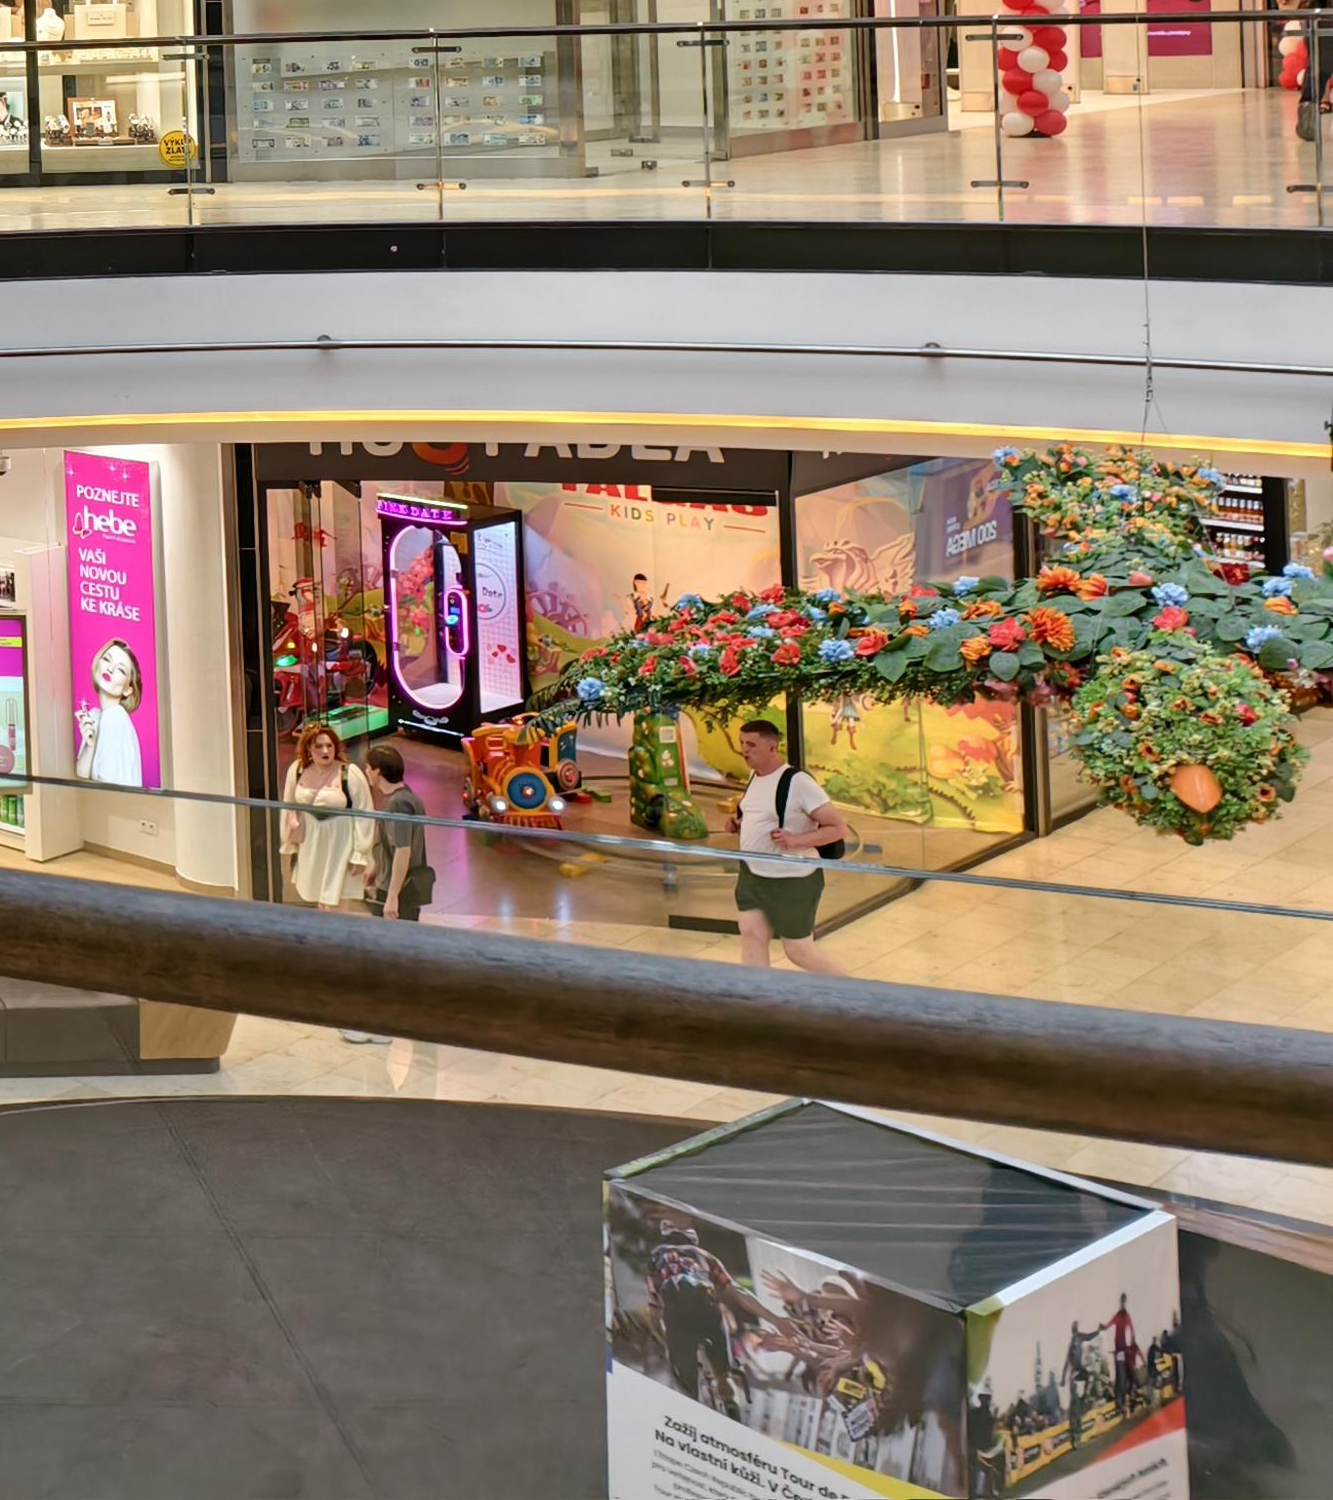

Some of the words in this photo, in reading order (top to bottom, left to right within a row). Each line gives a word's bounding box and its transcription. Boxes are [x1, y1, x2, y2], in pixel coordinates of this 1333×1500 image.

[76, 484, 140, 508] POZNEJTE
[83, 505, 137, 537] hebe
[410, 506, 453, 520] DATE
[609, 503, 655, 523] KIDS
[665, 511, 716, 533] PLAY
[78, 547, 107, 565] VAŠI
[79, 563, 128, 585] NOVOU
[79, 580, 120, 601] CESTU
[80, 597, 98, 613] KE
[98, 599, 142, 622] KRÁSE
[654, 1429, 676, 1448] Na
[676, 1441, 729, 1471] vlastní
[730, 1462, 766, 1488] kůži.
[767, 1480, 779, 1494] V
[664, 1415, 698, 1442] Zažij
[700, 1433, 779, 1476] atmosféru
[780, 1466, 815, 1492] Tour
